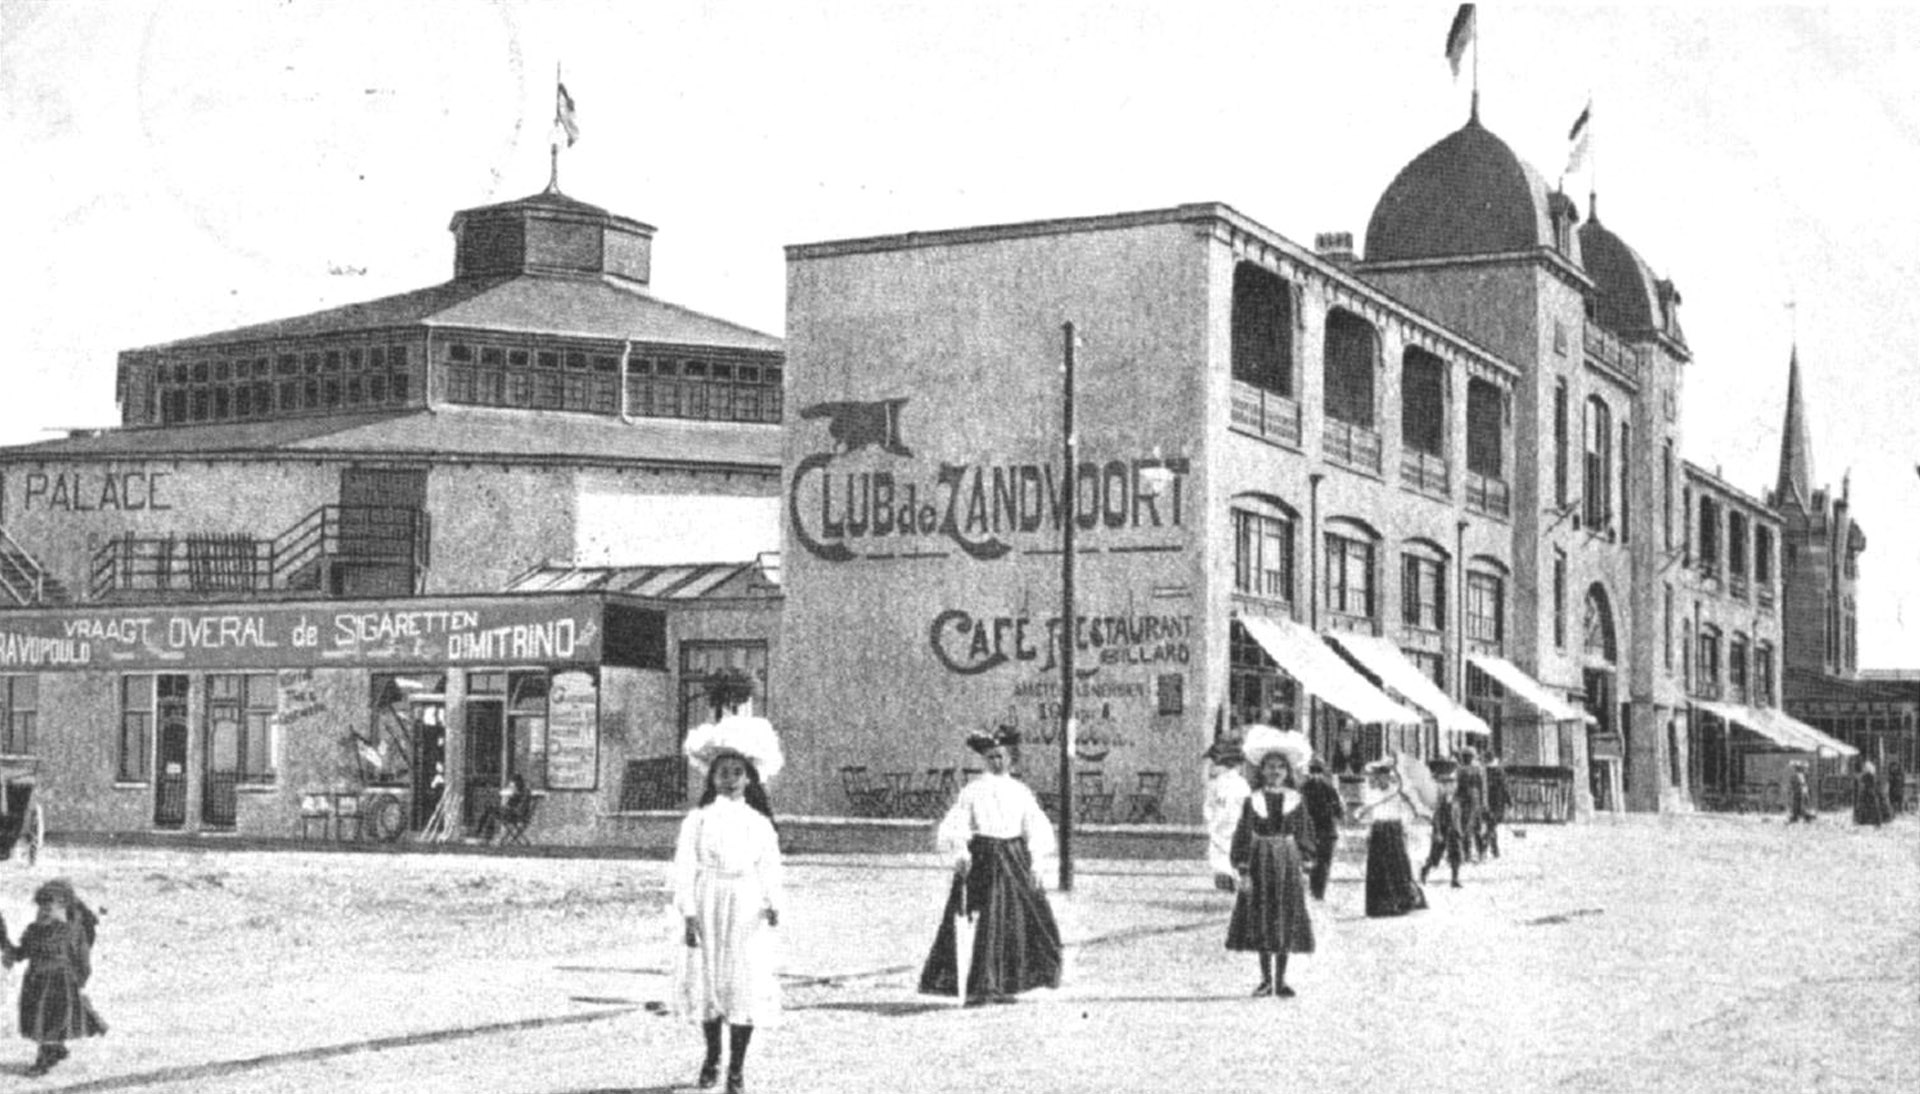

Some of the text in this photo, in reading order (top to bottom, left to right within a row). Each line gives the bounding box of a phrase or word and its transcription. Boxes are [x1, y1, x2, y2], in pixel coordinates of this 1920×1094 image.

[25, 472, 173, 511] PALACE
[789, 452, 1190, 562] CLUB de ZANDVOORT
[63, 609, 480, 650] VRAAGT OVERAL de SIGARETTEN
